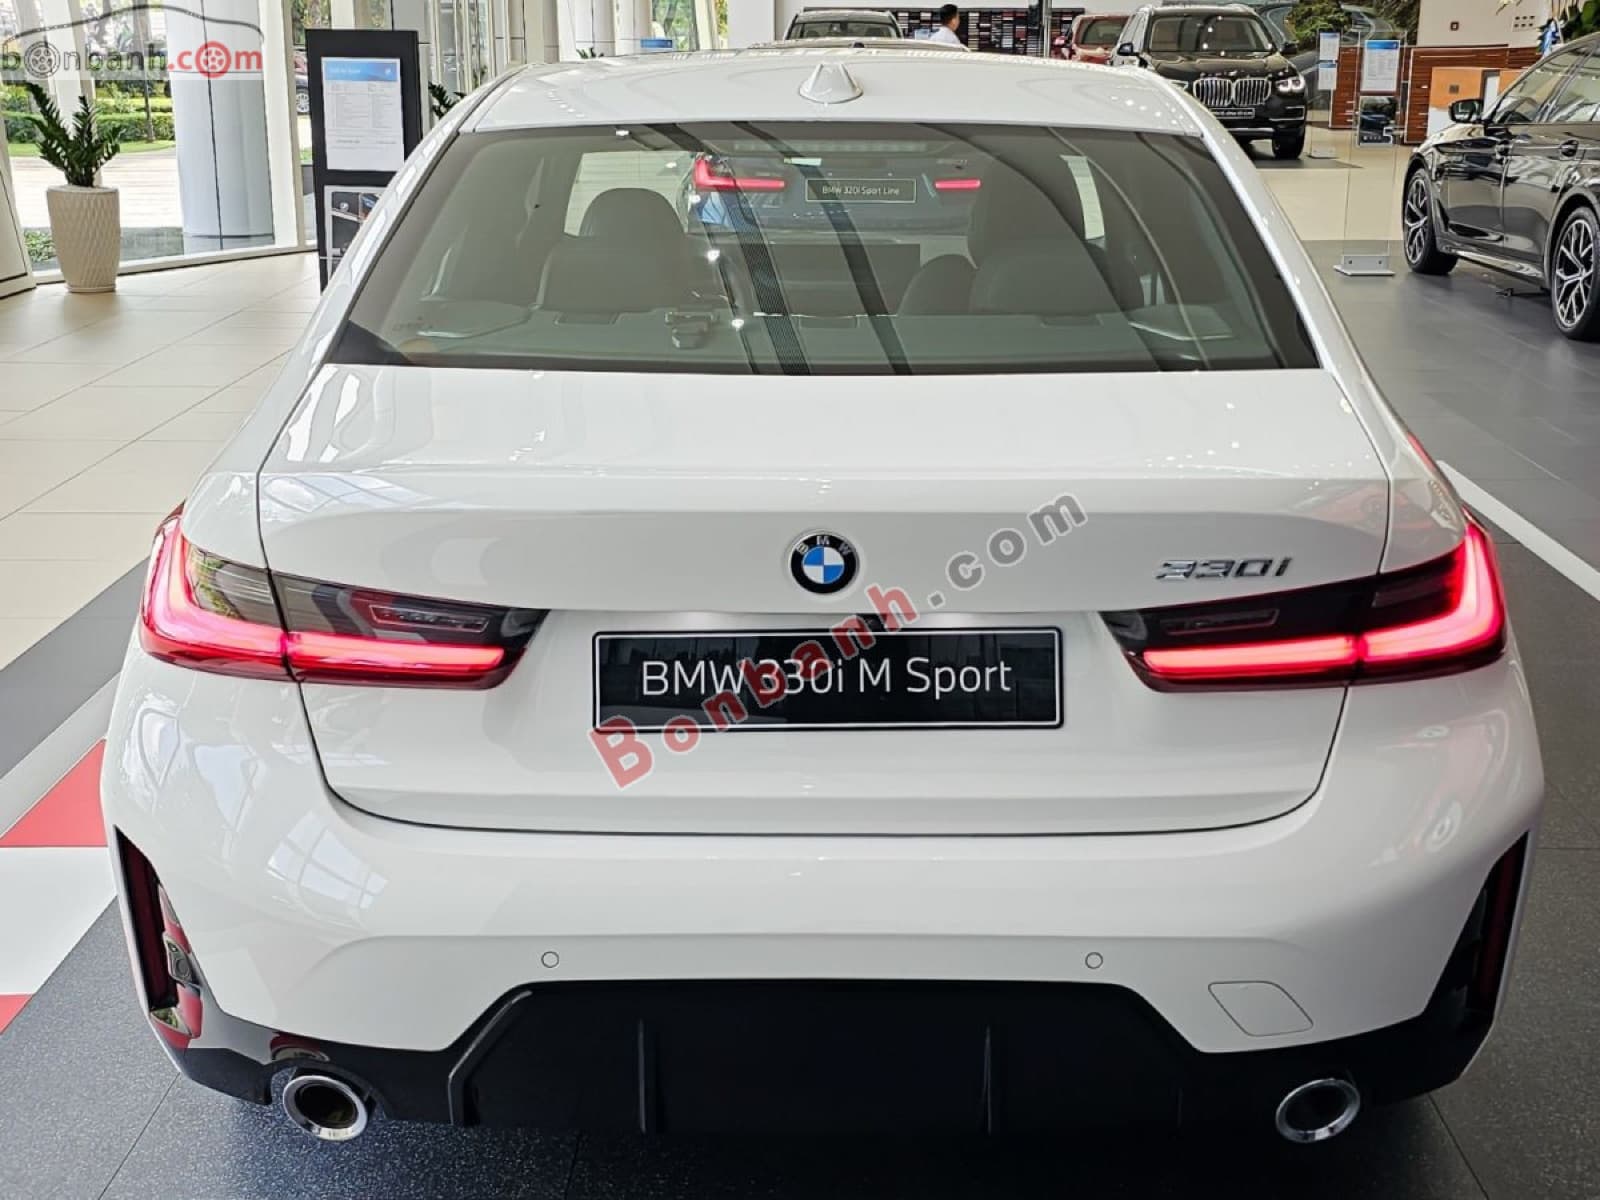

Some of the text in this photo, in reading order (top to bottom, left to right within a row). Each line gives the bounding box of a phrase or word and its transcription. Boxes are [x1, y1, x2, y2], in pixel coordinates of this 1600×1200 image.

[822, 185, 841, 195] BMW
[861, 186, 881, 196] Sport
[883, 186, 900, 195] Line
[796, 535, 852, 555] BMW
[642, 656, 1012, 700] BMW 330i M Sport
